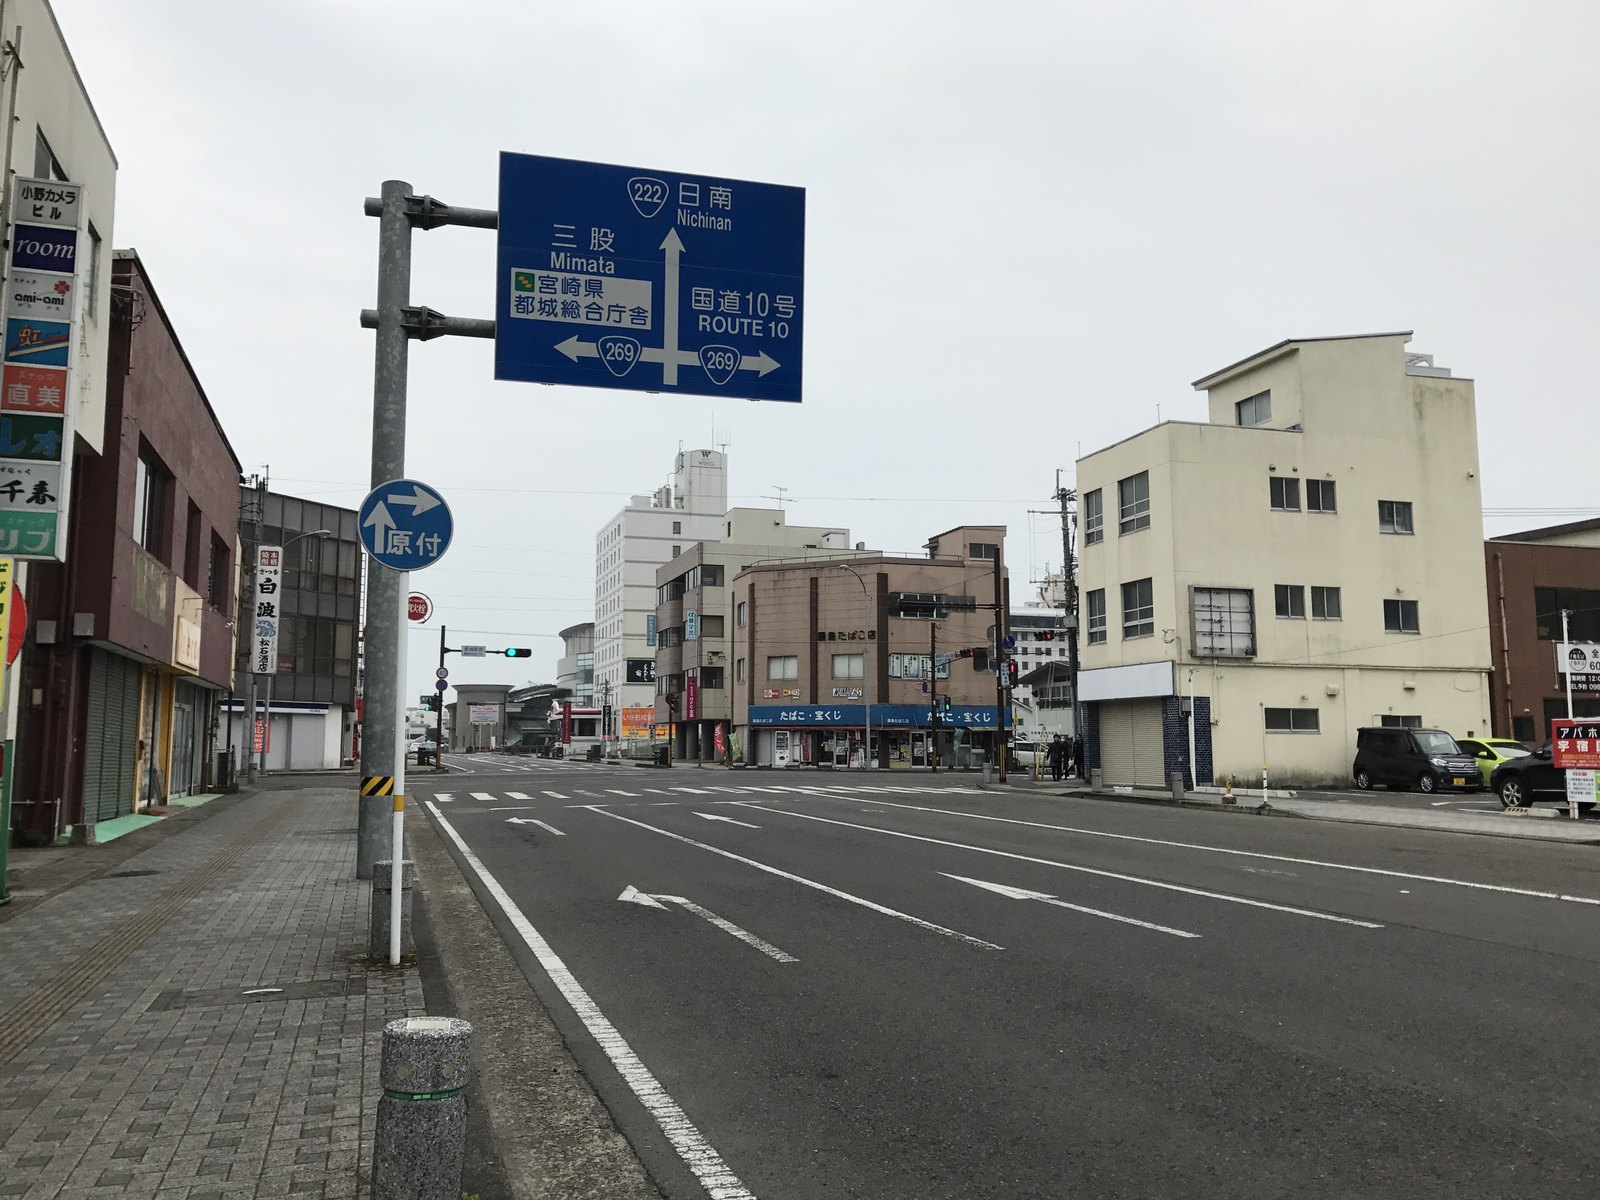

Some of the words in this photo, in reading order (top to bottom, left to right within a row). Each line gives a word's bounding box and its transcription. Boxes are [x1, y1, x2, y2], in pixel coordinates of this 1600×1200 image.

[21, 185, 76, 205] 小野カメラ
[634, 184, 662, 203] 222
[679, 181, 732, 210] 日南
[32, 204, 62, 220] ビル
[677, 209, 732, 231] Nichinan
[16, 239, 74, 259] room
[551, 224, 615, 252] 三股
[550, 252, 615, 274] Mimata
[538, 275, 604, 299] 宮崎県
[14, 292, 65, 306] ami-ami
[514, 294, 649, 326] 都城総合庁舎
[692, 287, 797, 319] 国道10号
[698, 316, 763, 337] ROUTE
[768, 321, 789, 339] 10
[605, 342, 634, 362] 269
[706, 351, 734, 371] 269
[7, 383, 61, 408] 直美
[387, 530, 442, 557] 原付
[1560, 726, 1598, 739] アパホ
